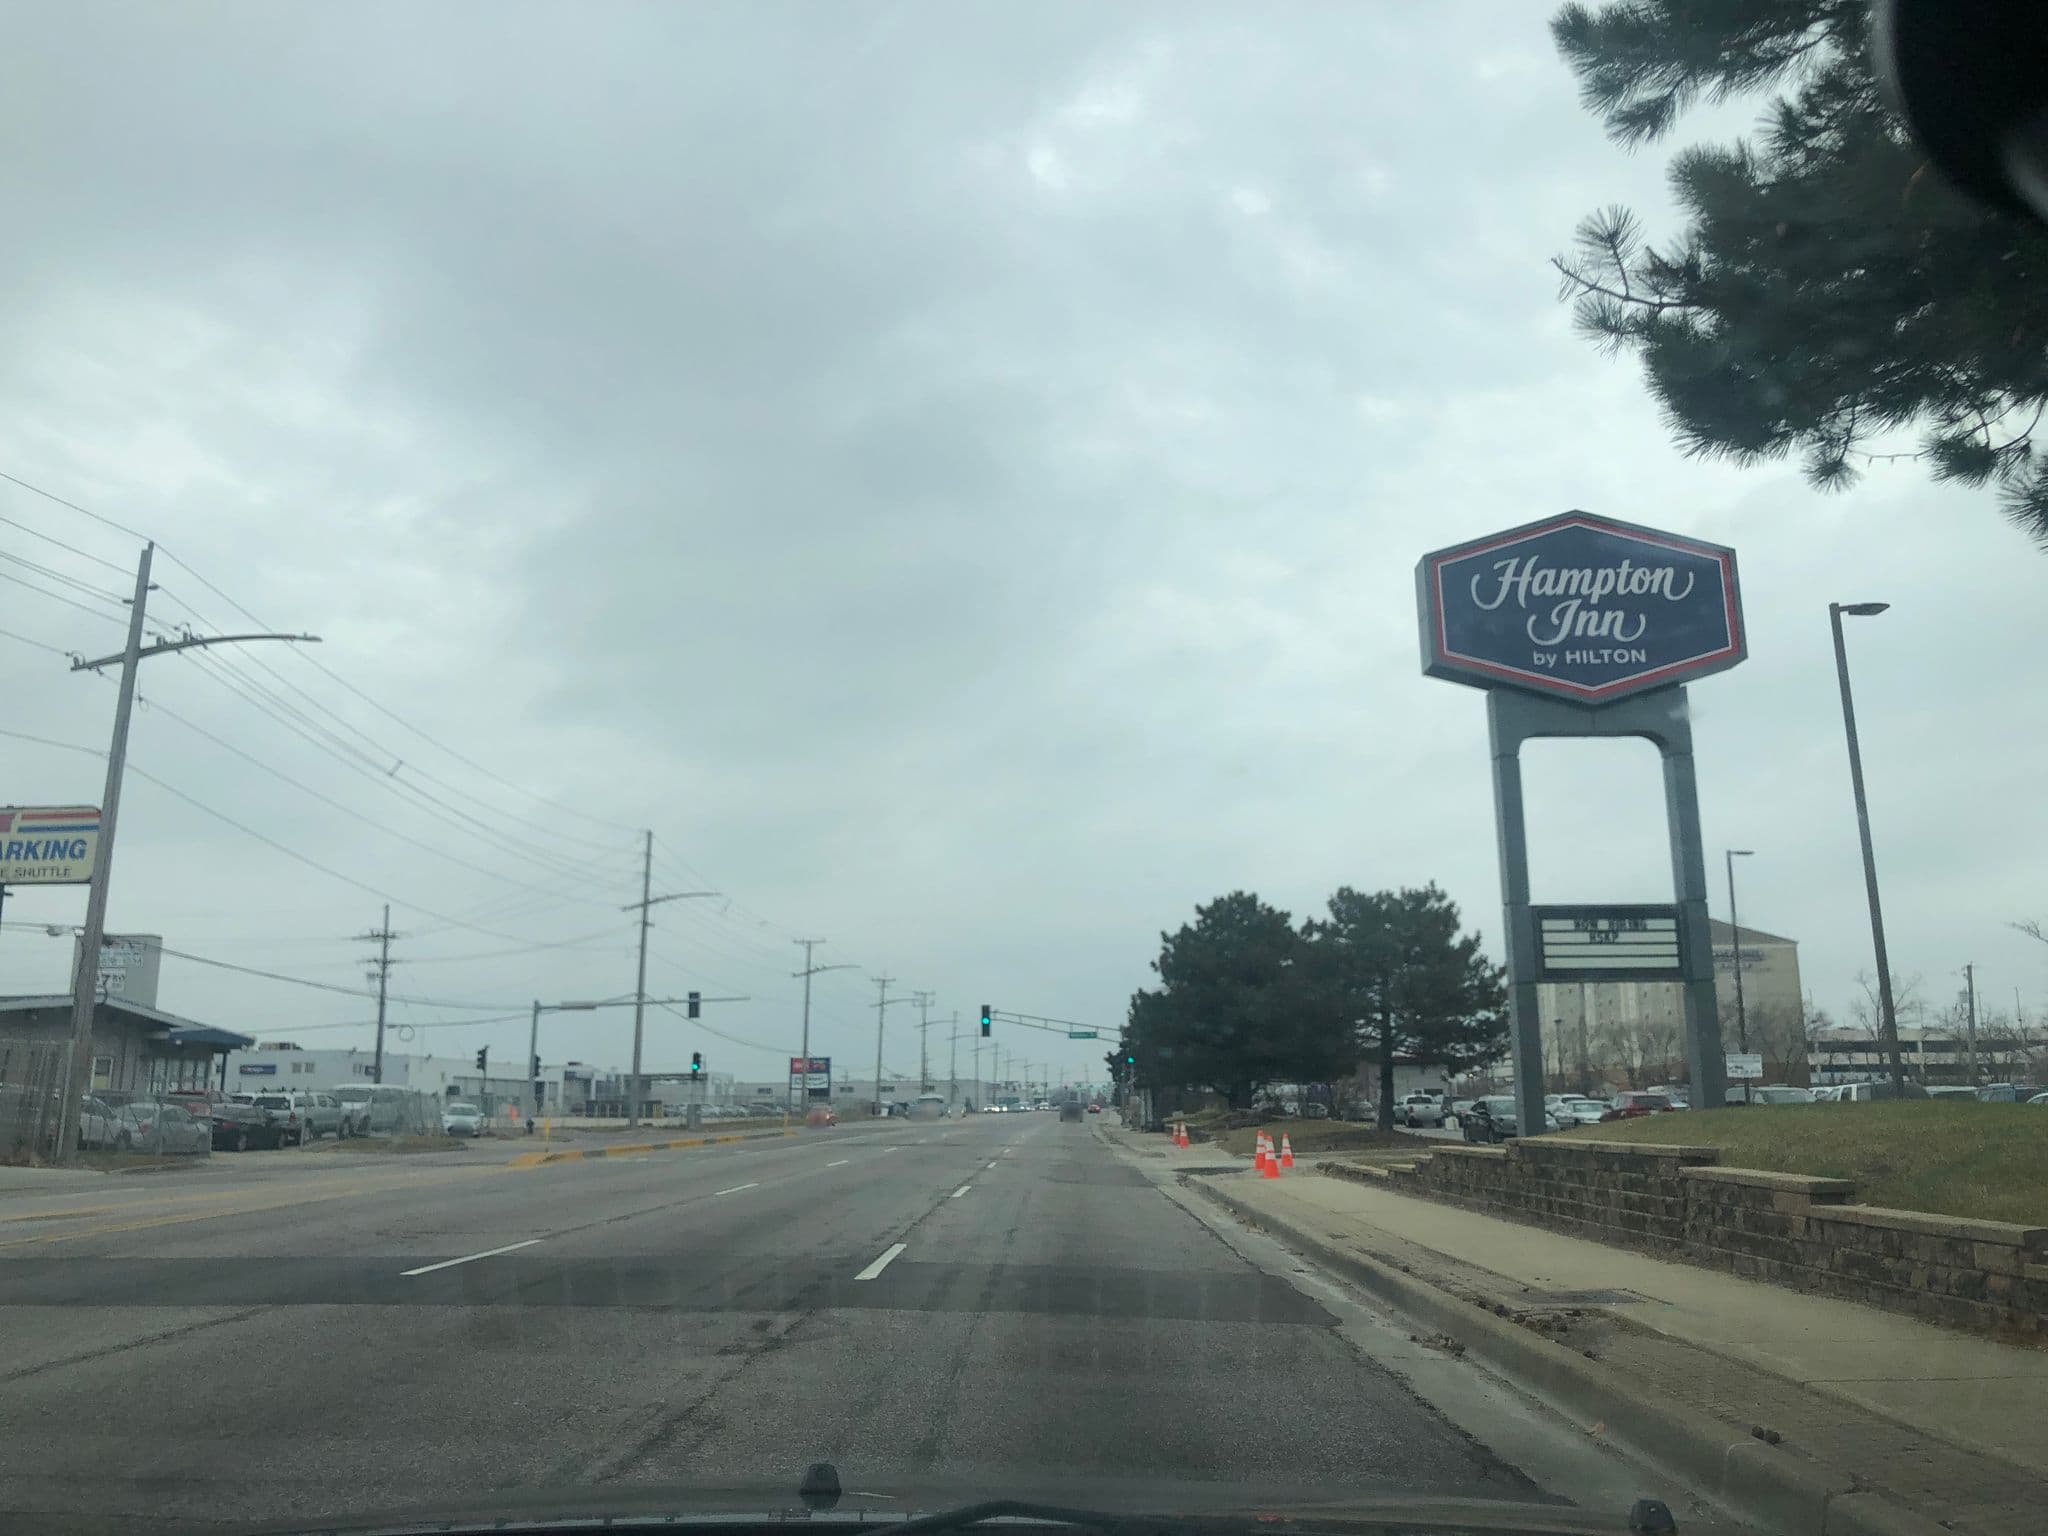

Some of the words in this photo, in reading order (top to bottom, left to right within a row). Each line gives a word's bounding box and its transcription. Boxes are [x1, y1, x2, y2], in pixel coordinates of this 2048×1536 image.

[1470, 555, 1694, 610] Hampton
[1526, 598, 1646, 646] Inn
[1533, 651, 1557, 667] by
[1566, 649, 1646, 665] HILTON
[0, 839, 87, 861] RKING
[14, 866, 72, 878] SHUTTLE
